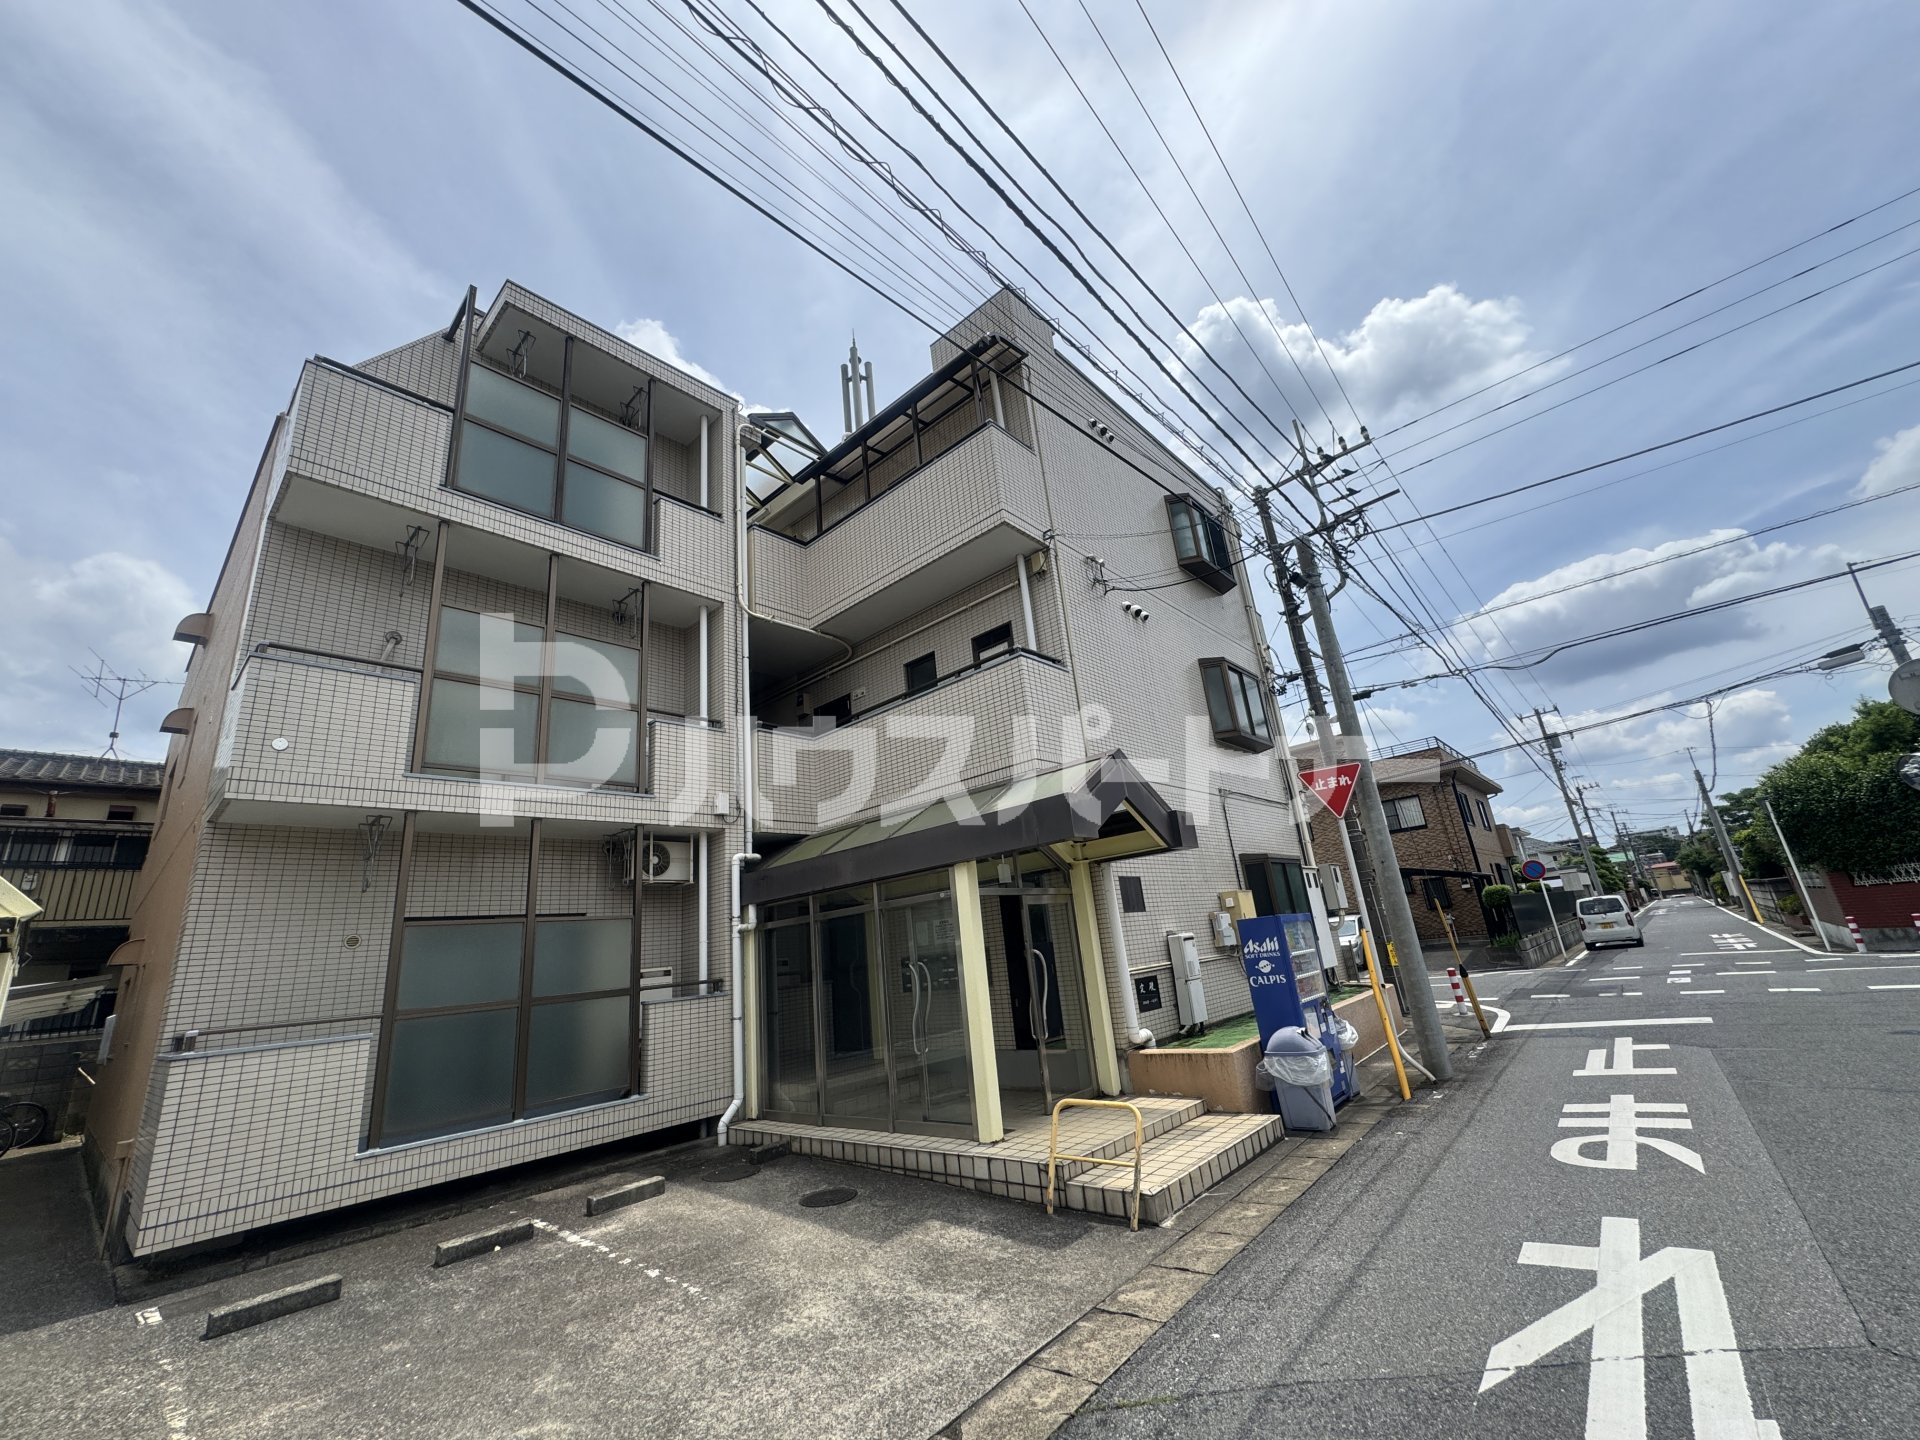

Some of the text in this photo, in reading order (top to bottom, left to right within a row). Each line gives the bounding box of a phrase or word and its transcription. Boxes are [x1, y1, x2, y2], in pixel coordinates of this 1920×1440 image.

[1314, 774, 1352, 791] 止まれ
[1244, 936, 1279, 954] Asahi
[1249, 974, 1286, 988] CALPIS
